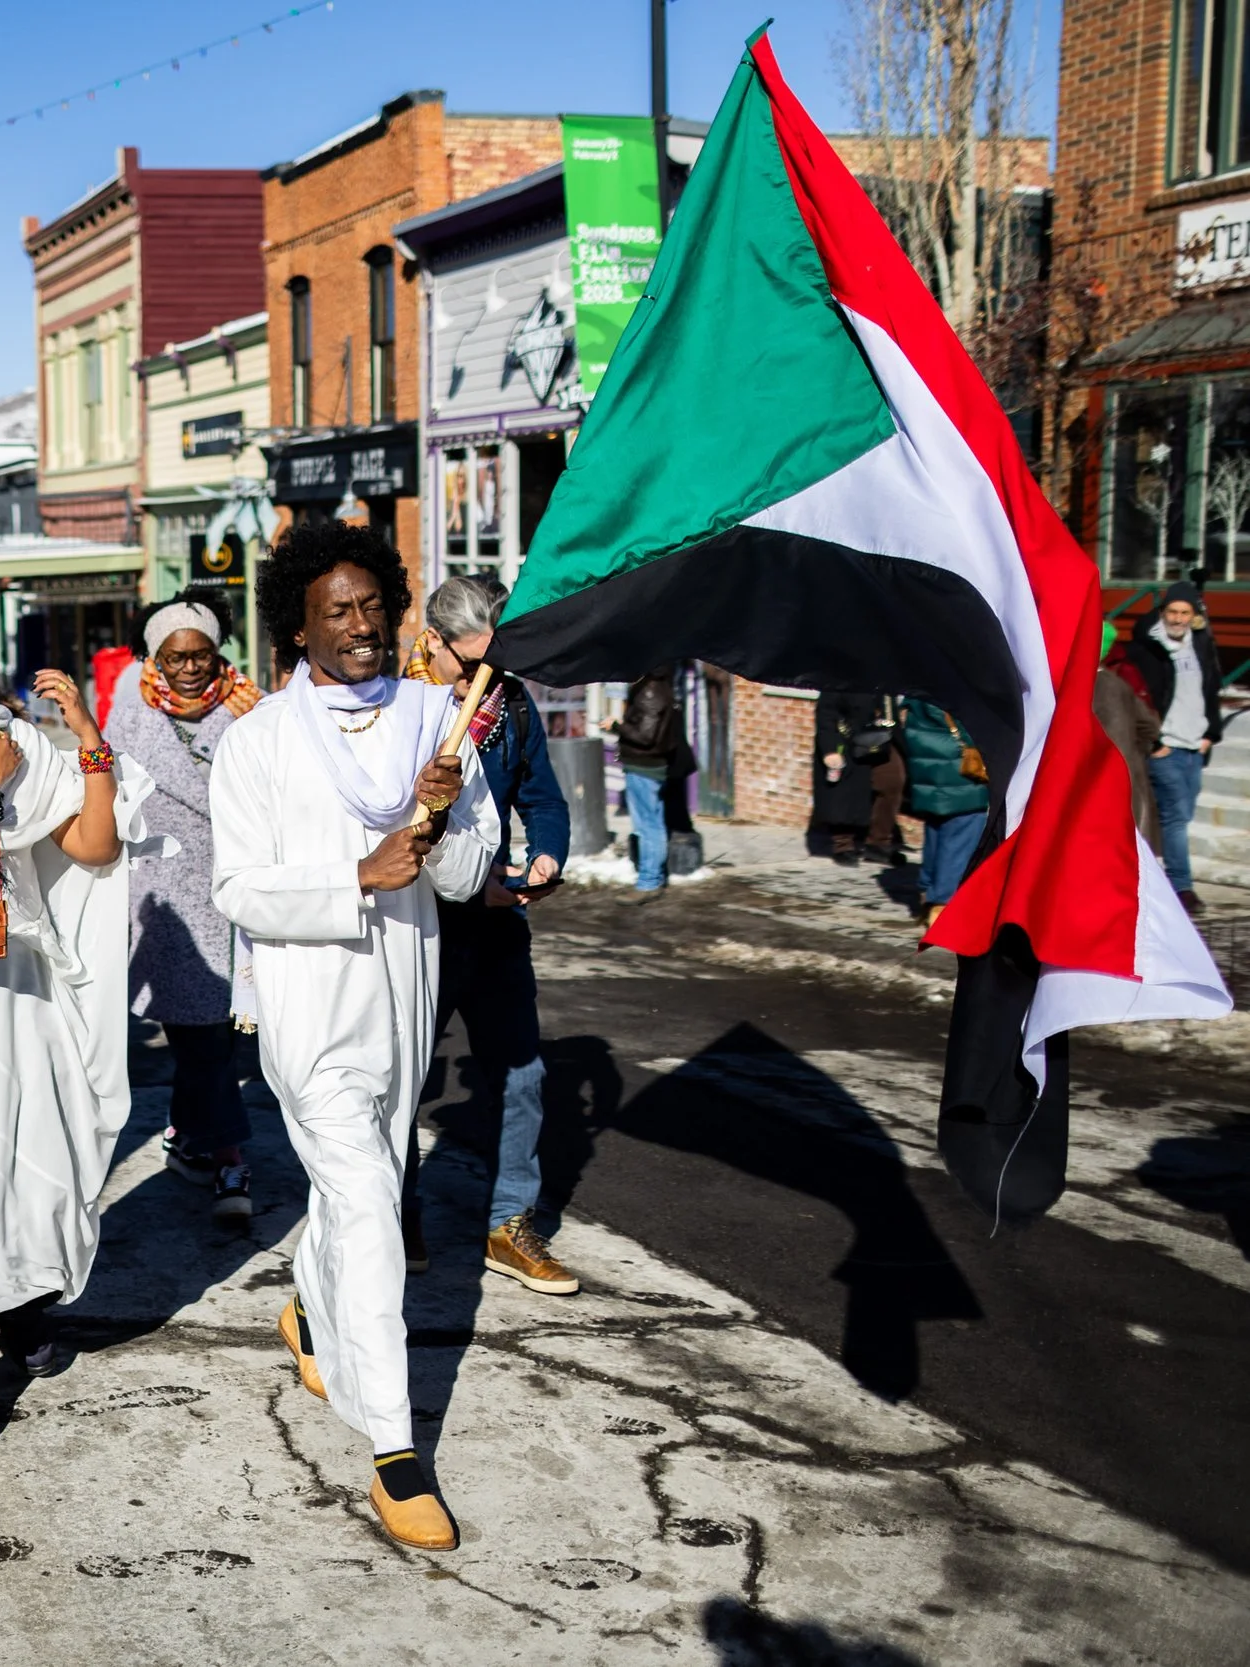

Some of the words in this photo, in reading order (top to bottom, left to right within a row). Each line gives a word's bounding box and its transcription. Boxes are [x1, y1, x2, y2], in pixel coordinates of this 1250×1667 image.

[576, 223, 656, 242] Sundance
[578, 243, 621, 261] Film
[582, 284, 623, 303] 2025
